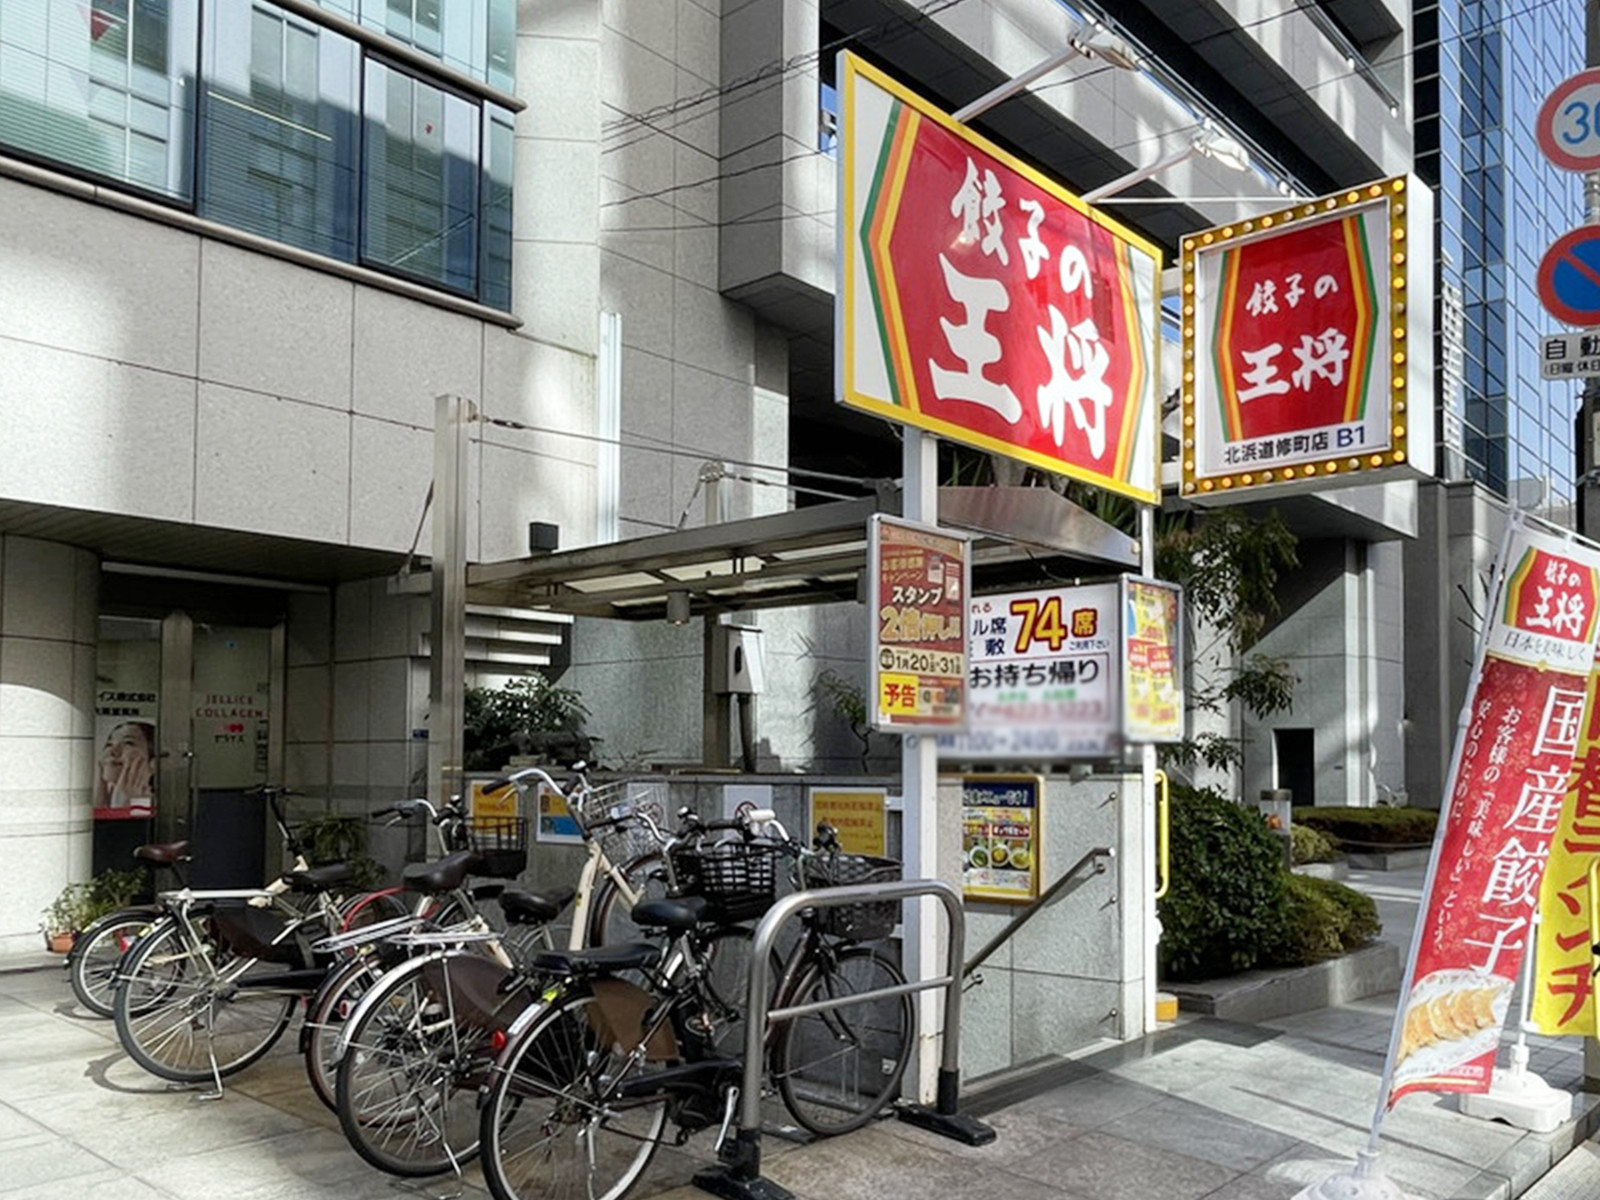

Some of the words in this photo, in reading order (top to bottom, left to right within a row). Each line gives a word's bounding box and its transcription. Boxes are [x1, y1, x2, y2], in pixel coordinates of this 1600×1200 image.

[950, 156, 1092, 299] 餃子の
[1245, 273, 1339, 317] 餃子の
[928, 252, 1112, 460] 王将
[1236, 327, 1349, 403] 王将
[1224, 431, 1330, 464] 北浜道修町店
[1336, 426, 1366, 448] B1
[1544, 560, 1581, 587] 餃子の
[892, 585, 943, 605] スタンプ
[1525, 585, 1586, 638] 王将
[973, 617, 1007, 636] ル席
[1009, 596, 1068, 653] 74
[1071, 608, 1097, 637] 席
[969, 659, 1099, 688] お持ち帰り
[195, 708, 263, 718] COLLAGEN
[205, 695, 255, 704] JELLICE
[884, 683, 916, 707] 予告
[1463, 685, 1588, 976] 国産餃子
